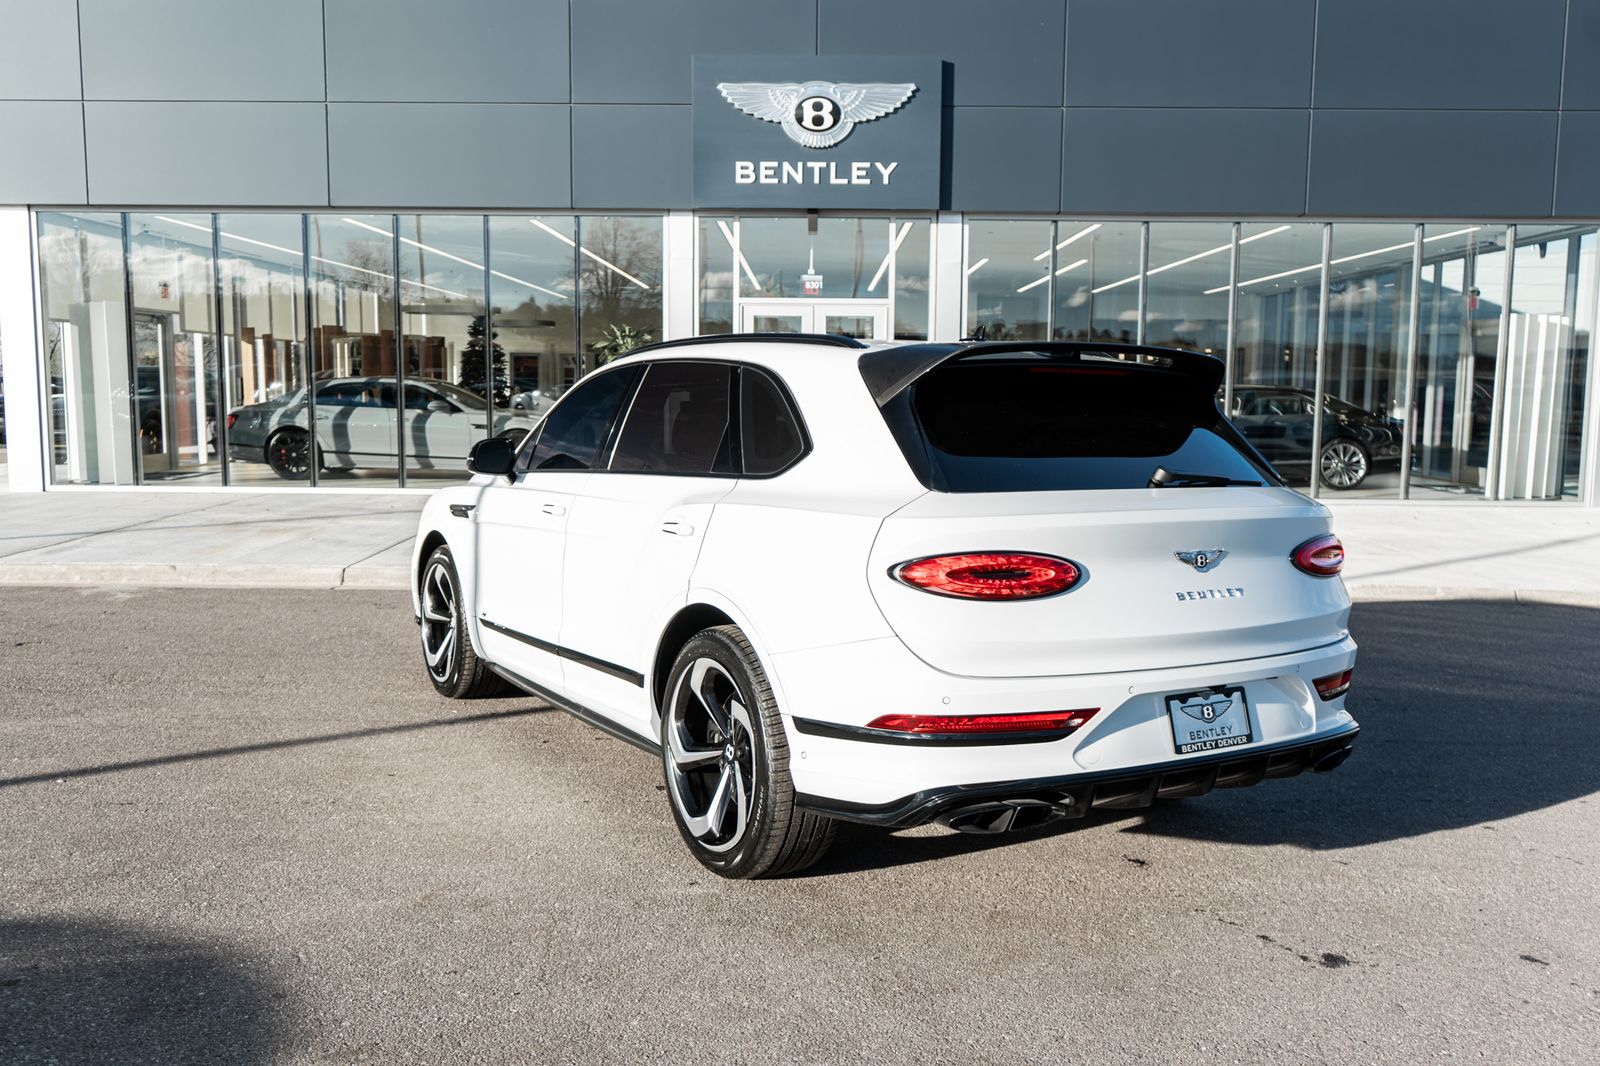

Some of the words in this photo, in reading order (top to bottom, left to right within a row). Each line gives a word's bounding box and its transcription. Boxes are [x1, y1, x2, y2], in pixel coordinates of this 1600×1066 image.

[735, 161, 898, 185] BENTLEY
[1176, 587, 1244, 601] BENTLEY
[1189, 725, 1233, 741] BENTLEY
[1181, 740, 1217, 753] BENTLEY
[1217, 735, 1248, 748] DENVER
